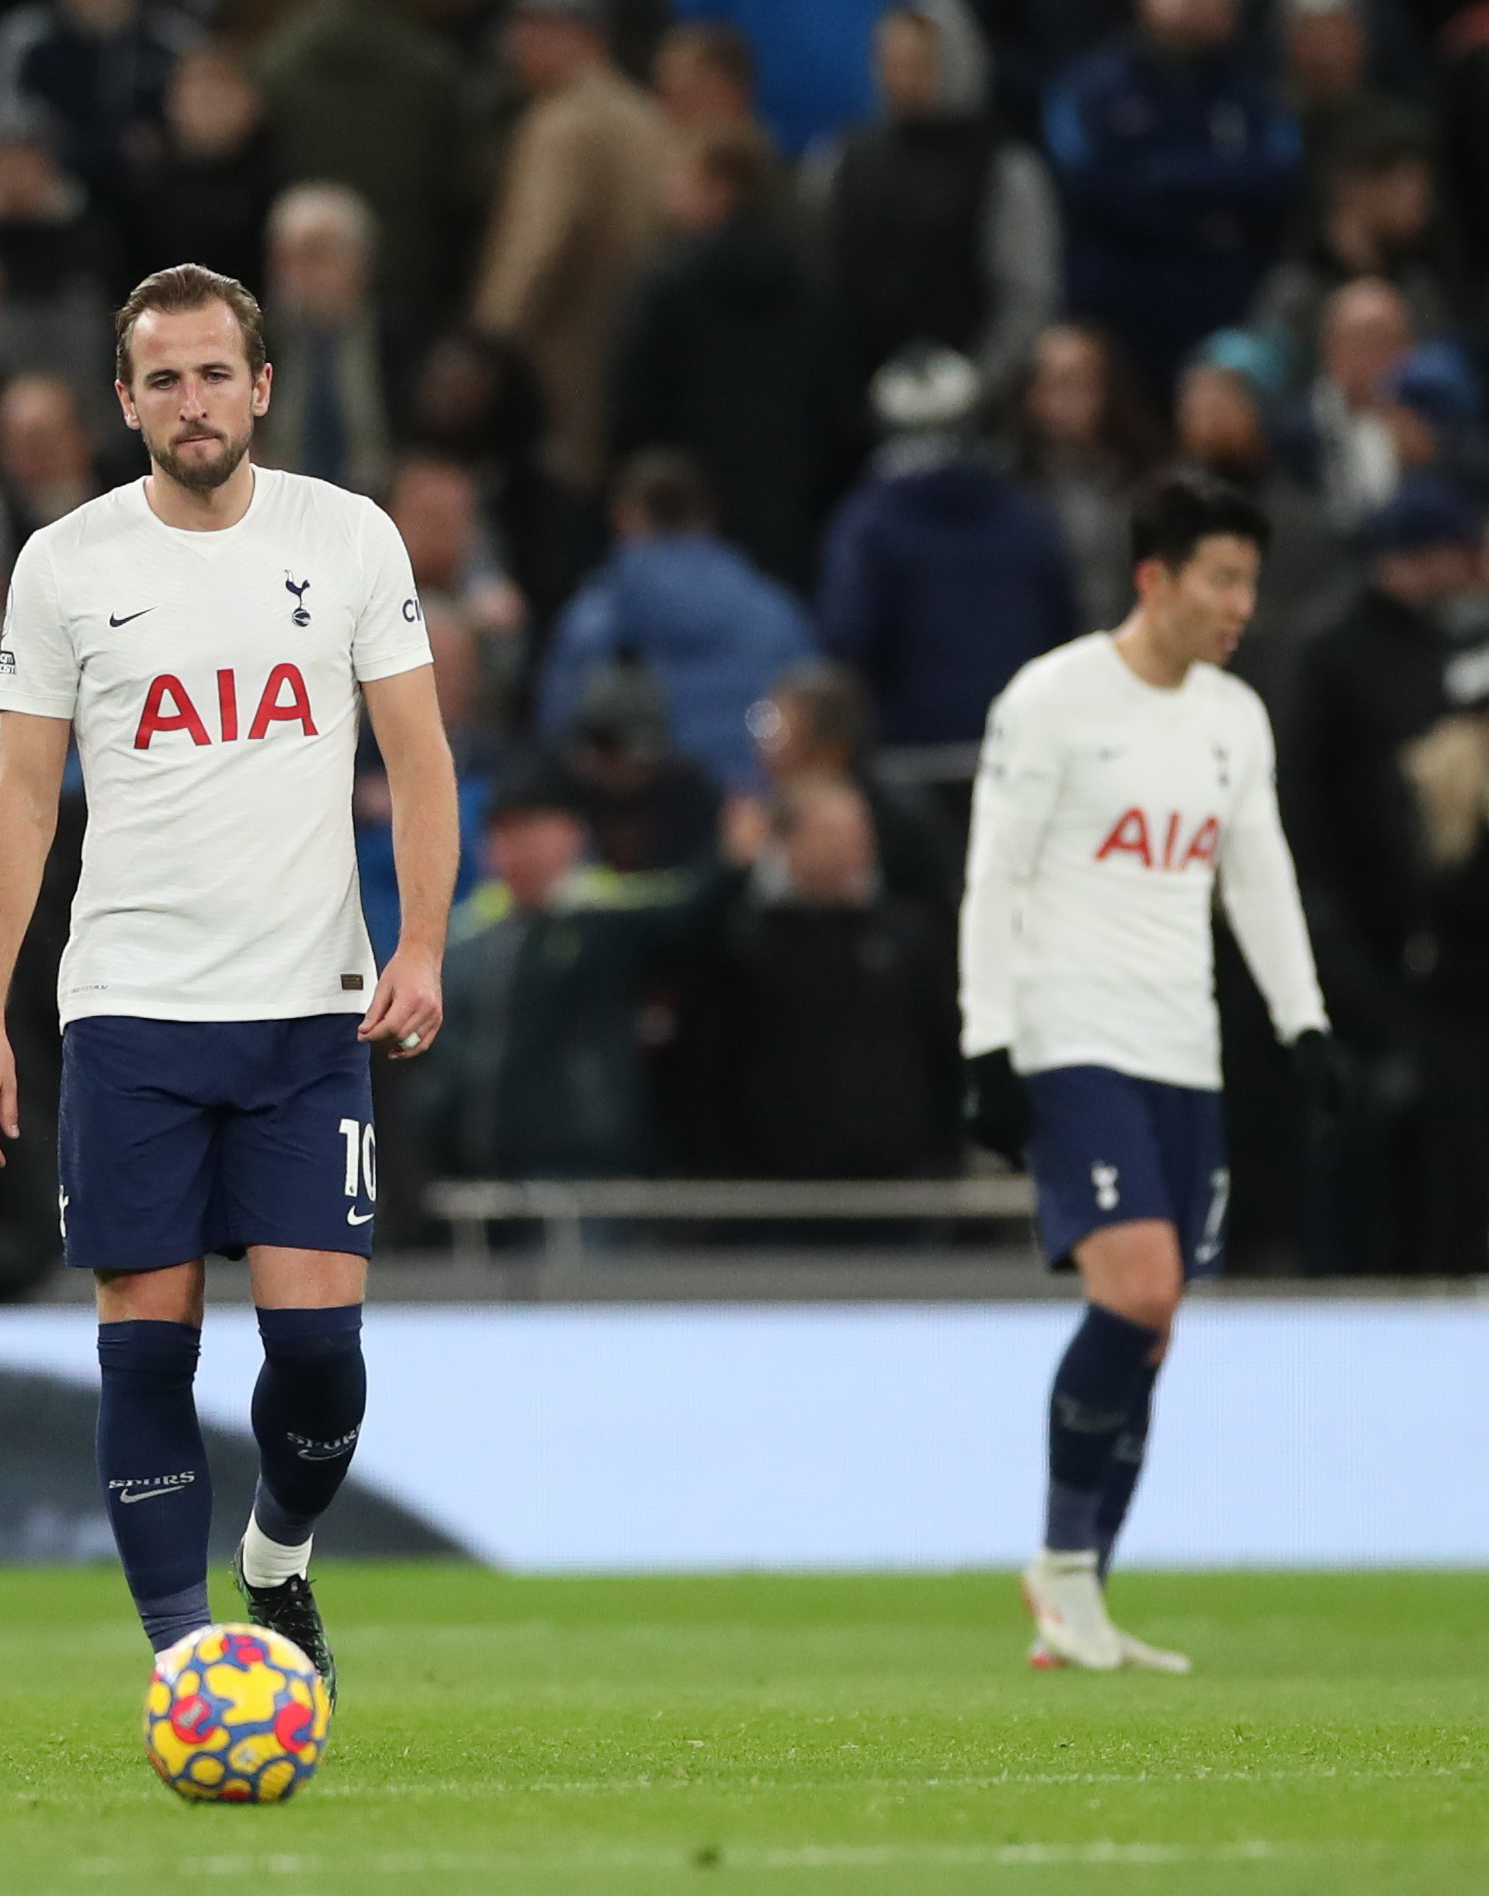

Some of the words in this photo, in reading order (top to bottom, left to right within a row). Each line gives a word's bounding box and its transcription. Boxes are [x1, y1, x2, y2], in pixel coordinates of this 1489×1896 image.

[134, 662, 319, 750] AIA
[1093, 804, 1221, 874] AIA
[338, 1118, 377, 1202] 10
[108, 1470, 195, 1489] SPURS
